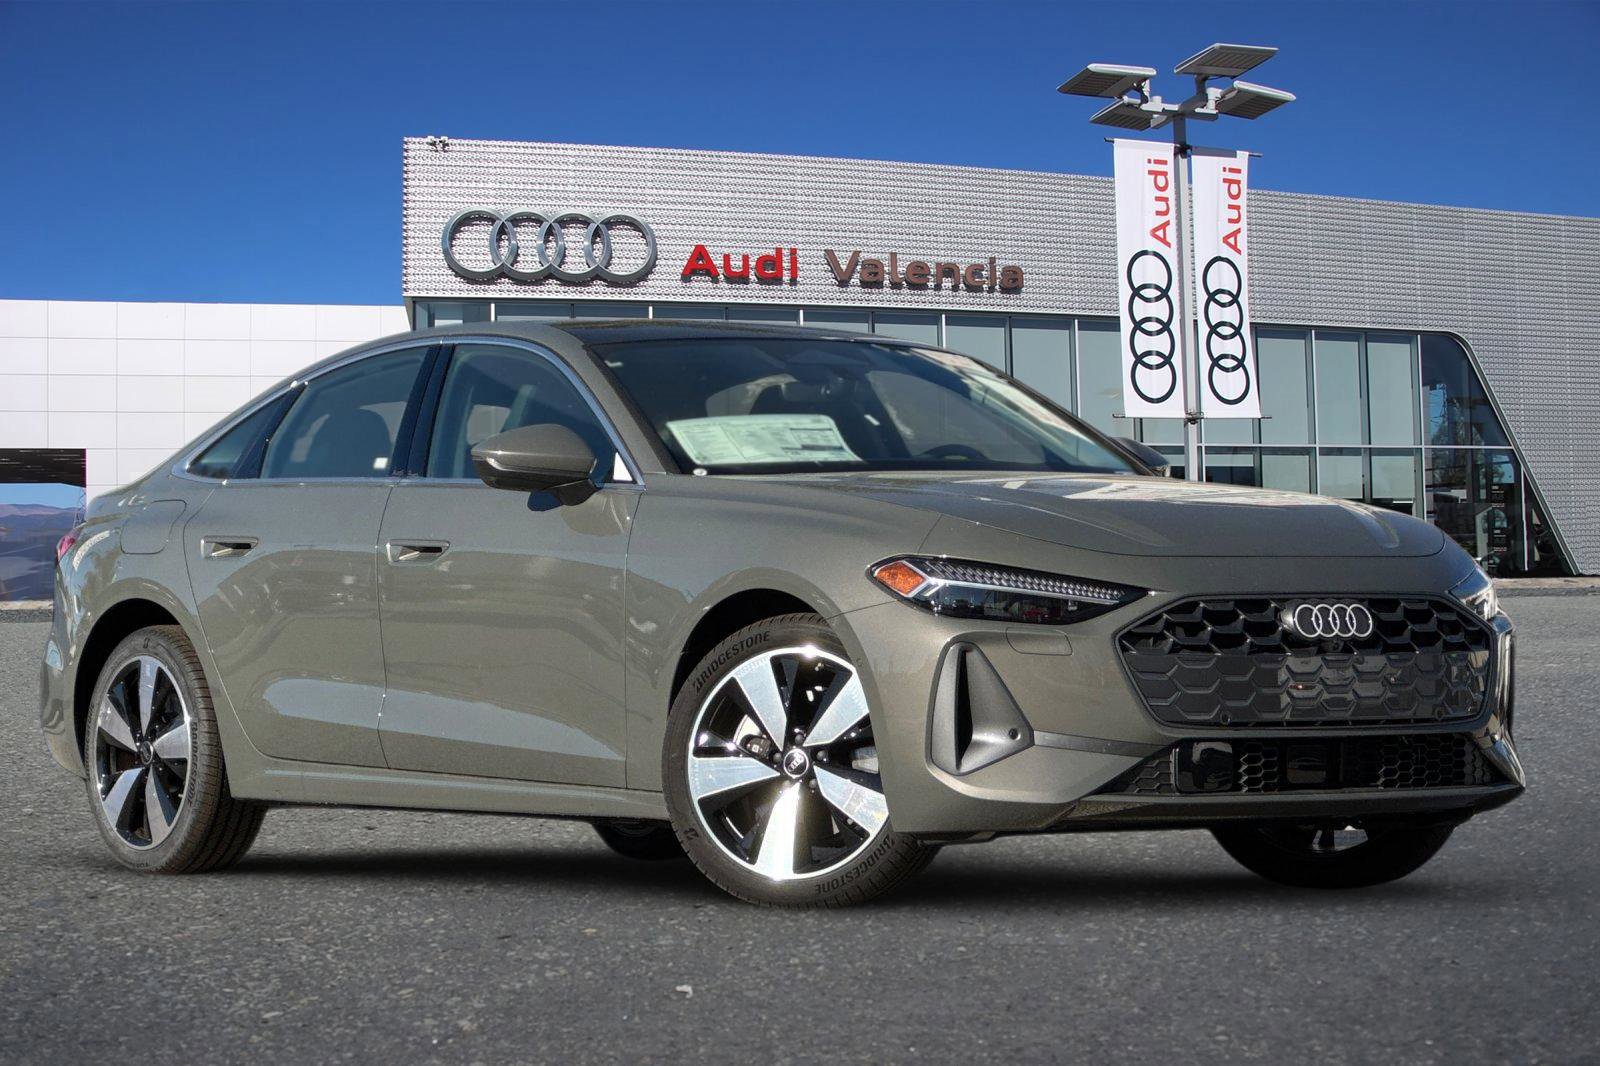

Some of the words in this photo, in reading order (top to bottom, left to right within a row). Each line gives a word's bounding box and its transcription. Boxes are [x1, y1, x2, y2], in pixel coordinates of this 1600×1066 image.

[1147, 158, 1171, 249] Audi
[1222, 166, 1242, 255] Audi
[681, 243, 798, 284] Audi
[824, 249, 1025, 292] Valencia
[692, 630, 771, 696] BRIDGESTONE
[814, 833, 897, 894] BRIDGESTONE
